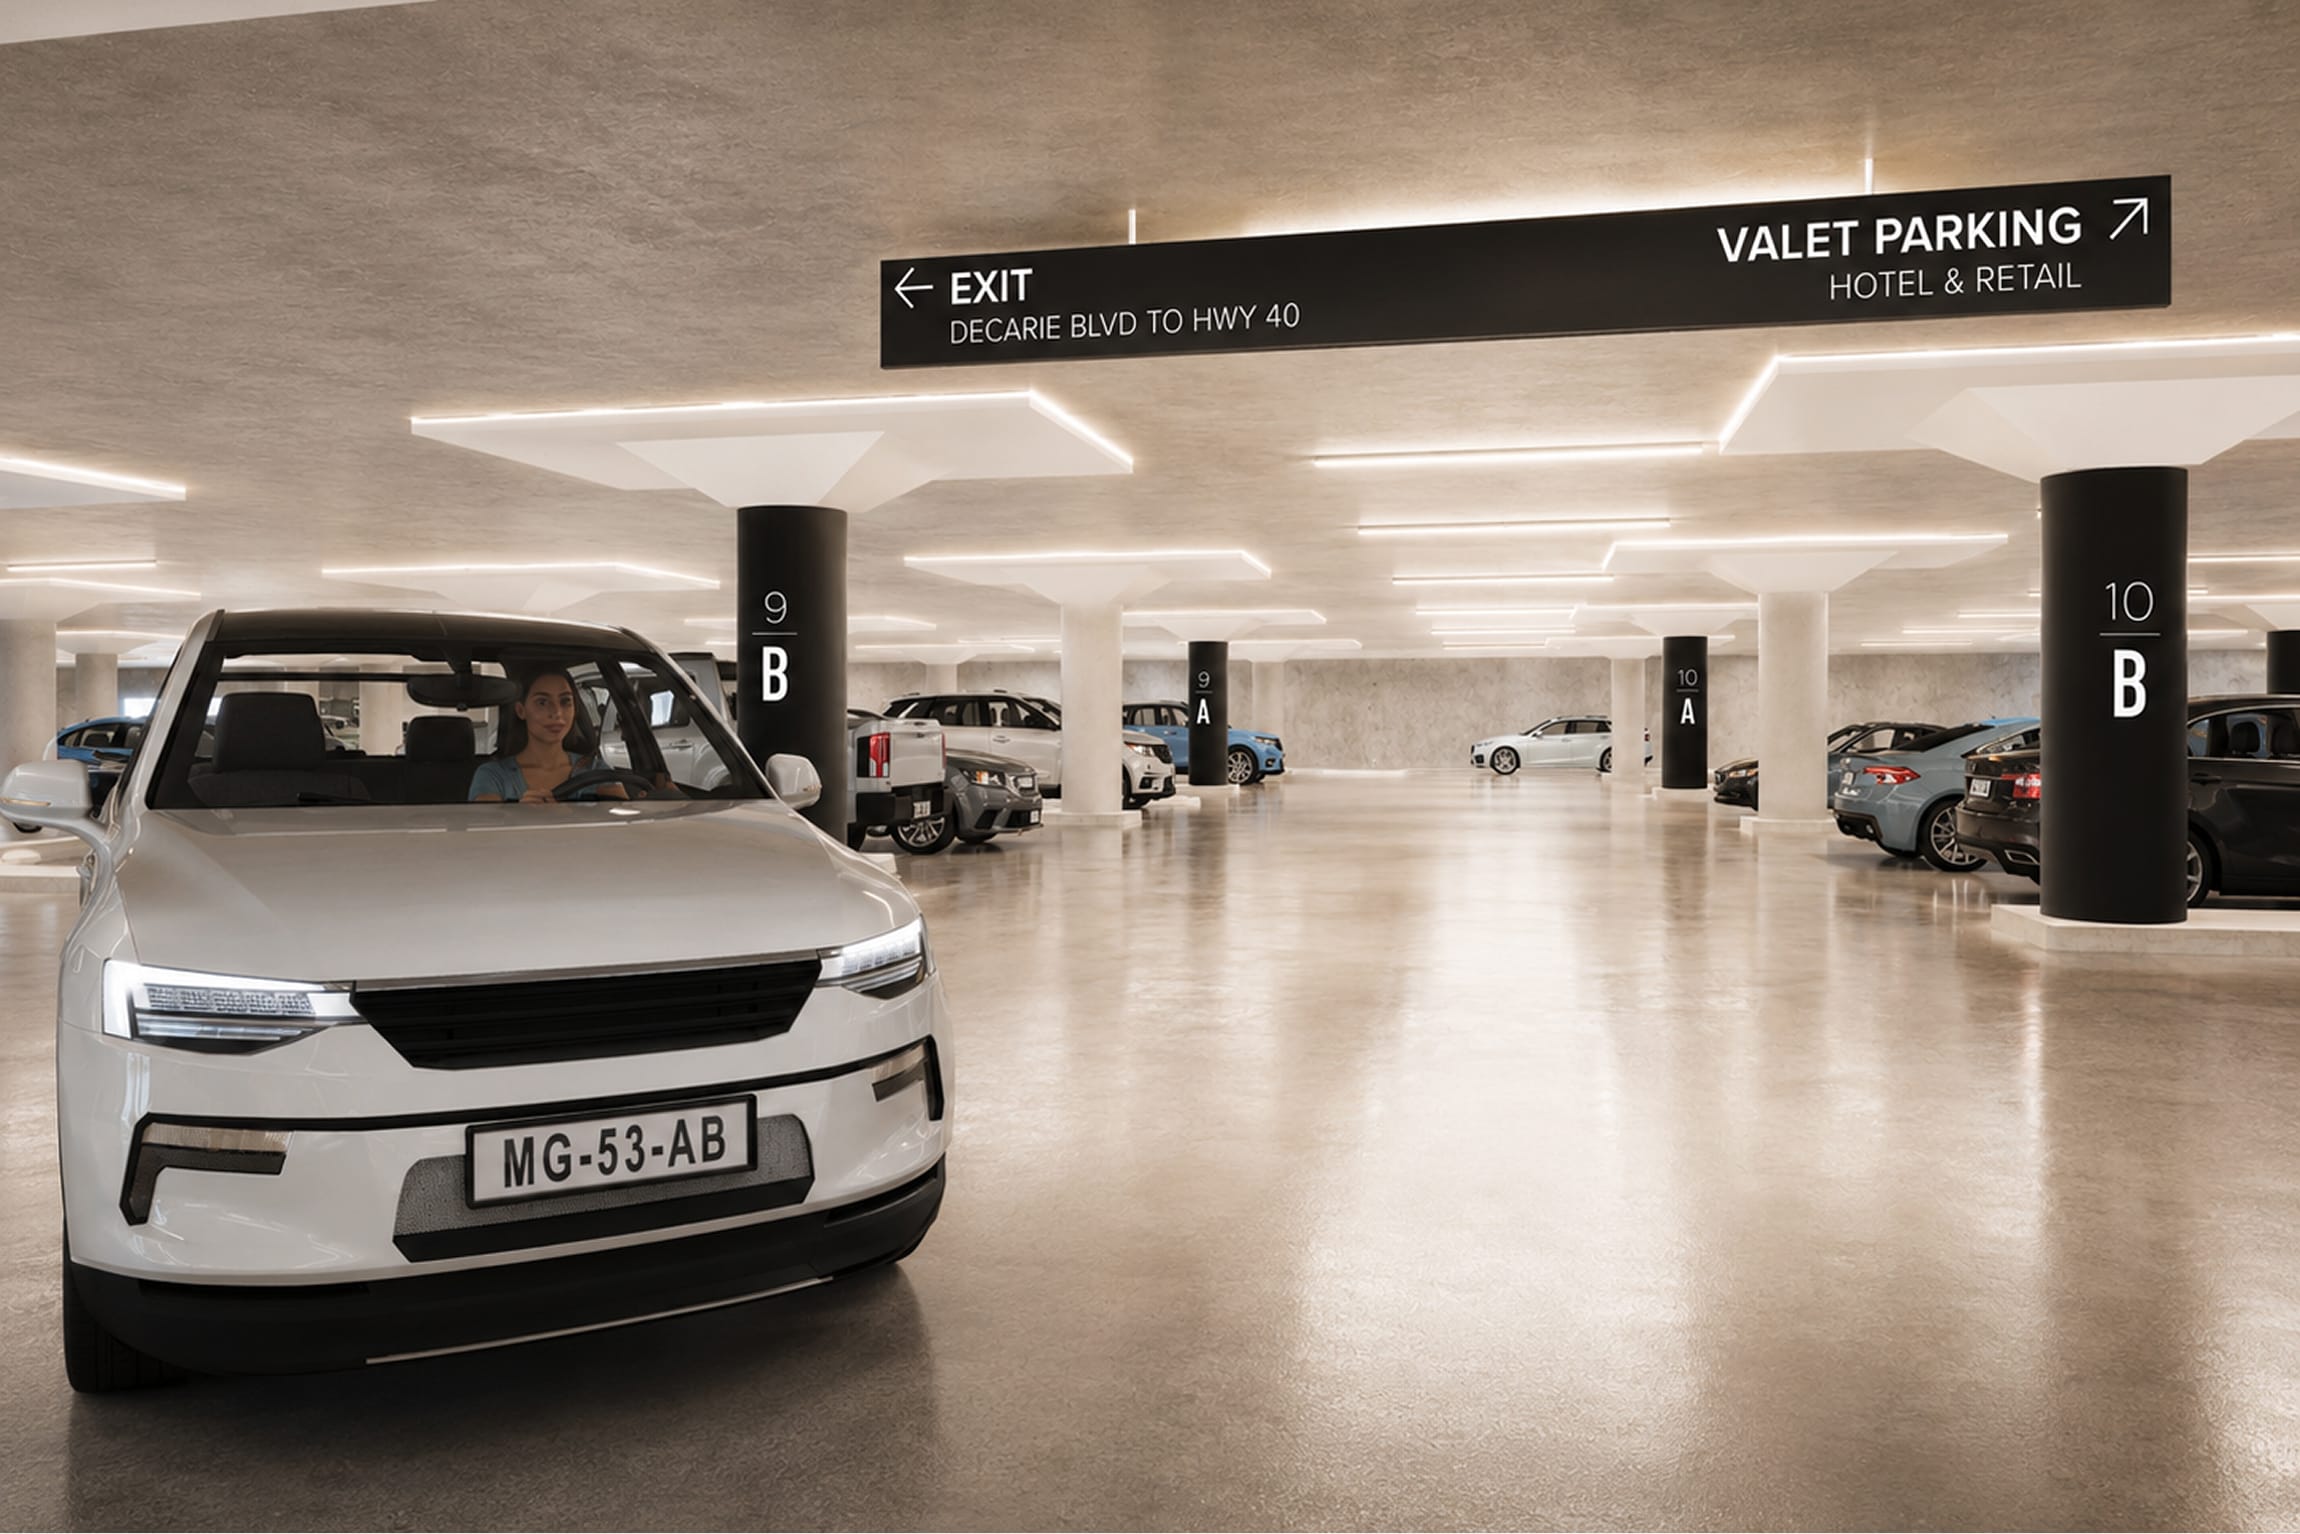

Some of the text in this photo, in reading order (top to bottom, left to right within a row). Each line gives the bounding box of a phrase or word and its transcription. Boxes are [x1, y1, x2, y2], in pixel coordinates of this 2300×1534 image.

[1716, 206, 2082, 263] VALET PARKING
[950, 267, 1034, 305] EXIT
[1830, 261, 2082, 301] HOTEL & RETAIL
[950, 302, 1300, 345] DECARIE BLVD TO HWY 40
[764, 591, 788, 625] 9
[2105, 581, 2154, 622] 10
[762, 646, 789, 702] B
[1197, 671, 1210, 688] 9
[1677, 669, 1698, 686] 10
[2113, 649, 2147, 718] B
[1196, 698, 1211, 725] A
[1680, 697, 1696, 725] A
[504, 1115, 726, 1188] MG-53-AB
